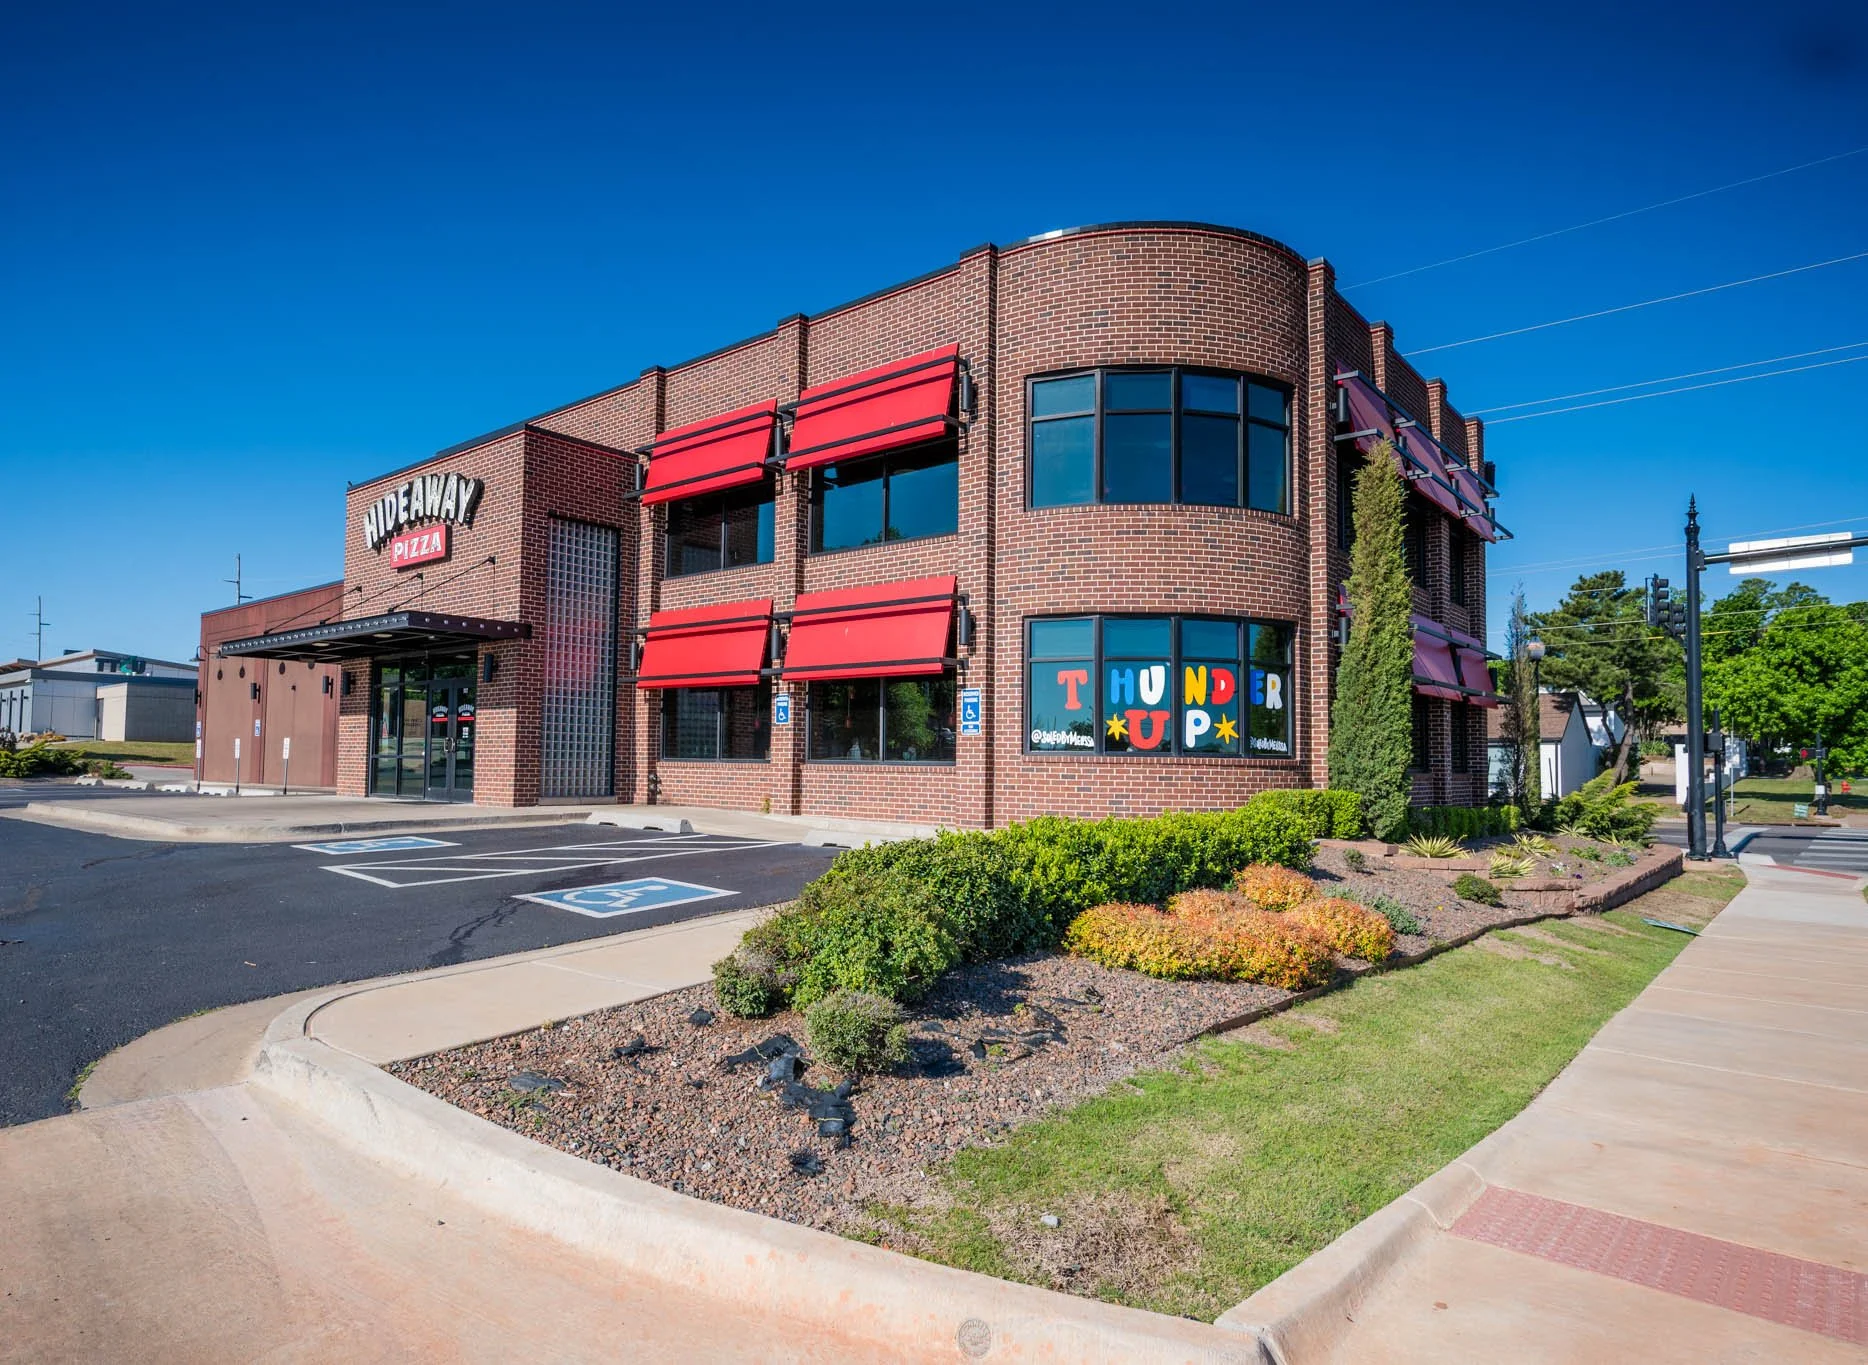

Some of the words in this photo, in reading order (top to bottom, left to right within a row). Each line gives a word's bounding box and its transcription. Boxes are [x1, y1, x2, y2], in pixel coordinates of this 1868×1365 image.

[363, 472, 477, 549] HIDEAWAY
[393, 531, 442, 561] PIZZA
[1057, 665, 1283, 710] THUNDER
[1124, 709, 1211, 750] UP
